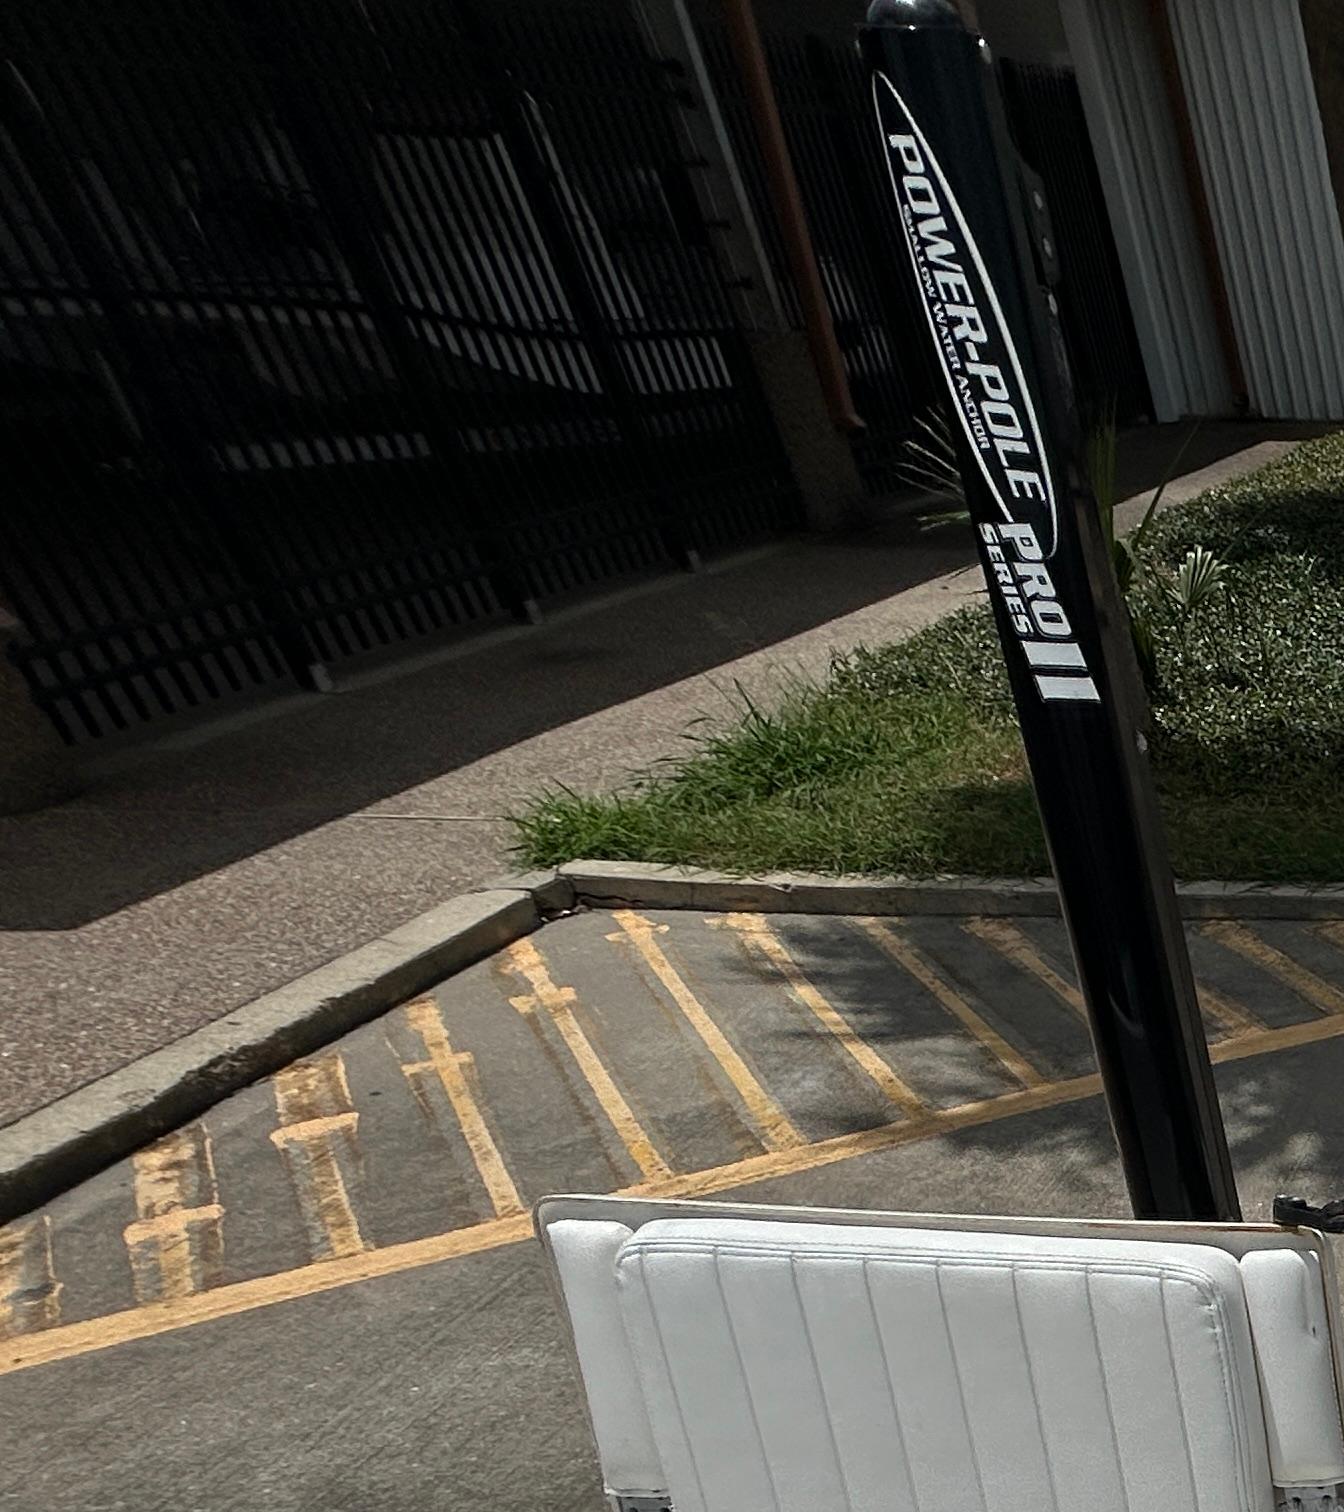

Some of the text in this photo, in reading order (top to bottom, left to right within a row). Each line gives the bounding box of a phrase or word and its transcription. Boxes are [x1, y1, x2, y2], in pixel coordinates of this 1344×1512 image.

[888, 133, 1046, 504] POWER-POLE
[933, 302, 962, 372] WATER
[955, 376, 991, 450] ANCHOR
[978, 521, 1034, 635] SERIES
[1000, 521, 1073, 638] PRO
